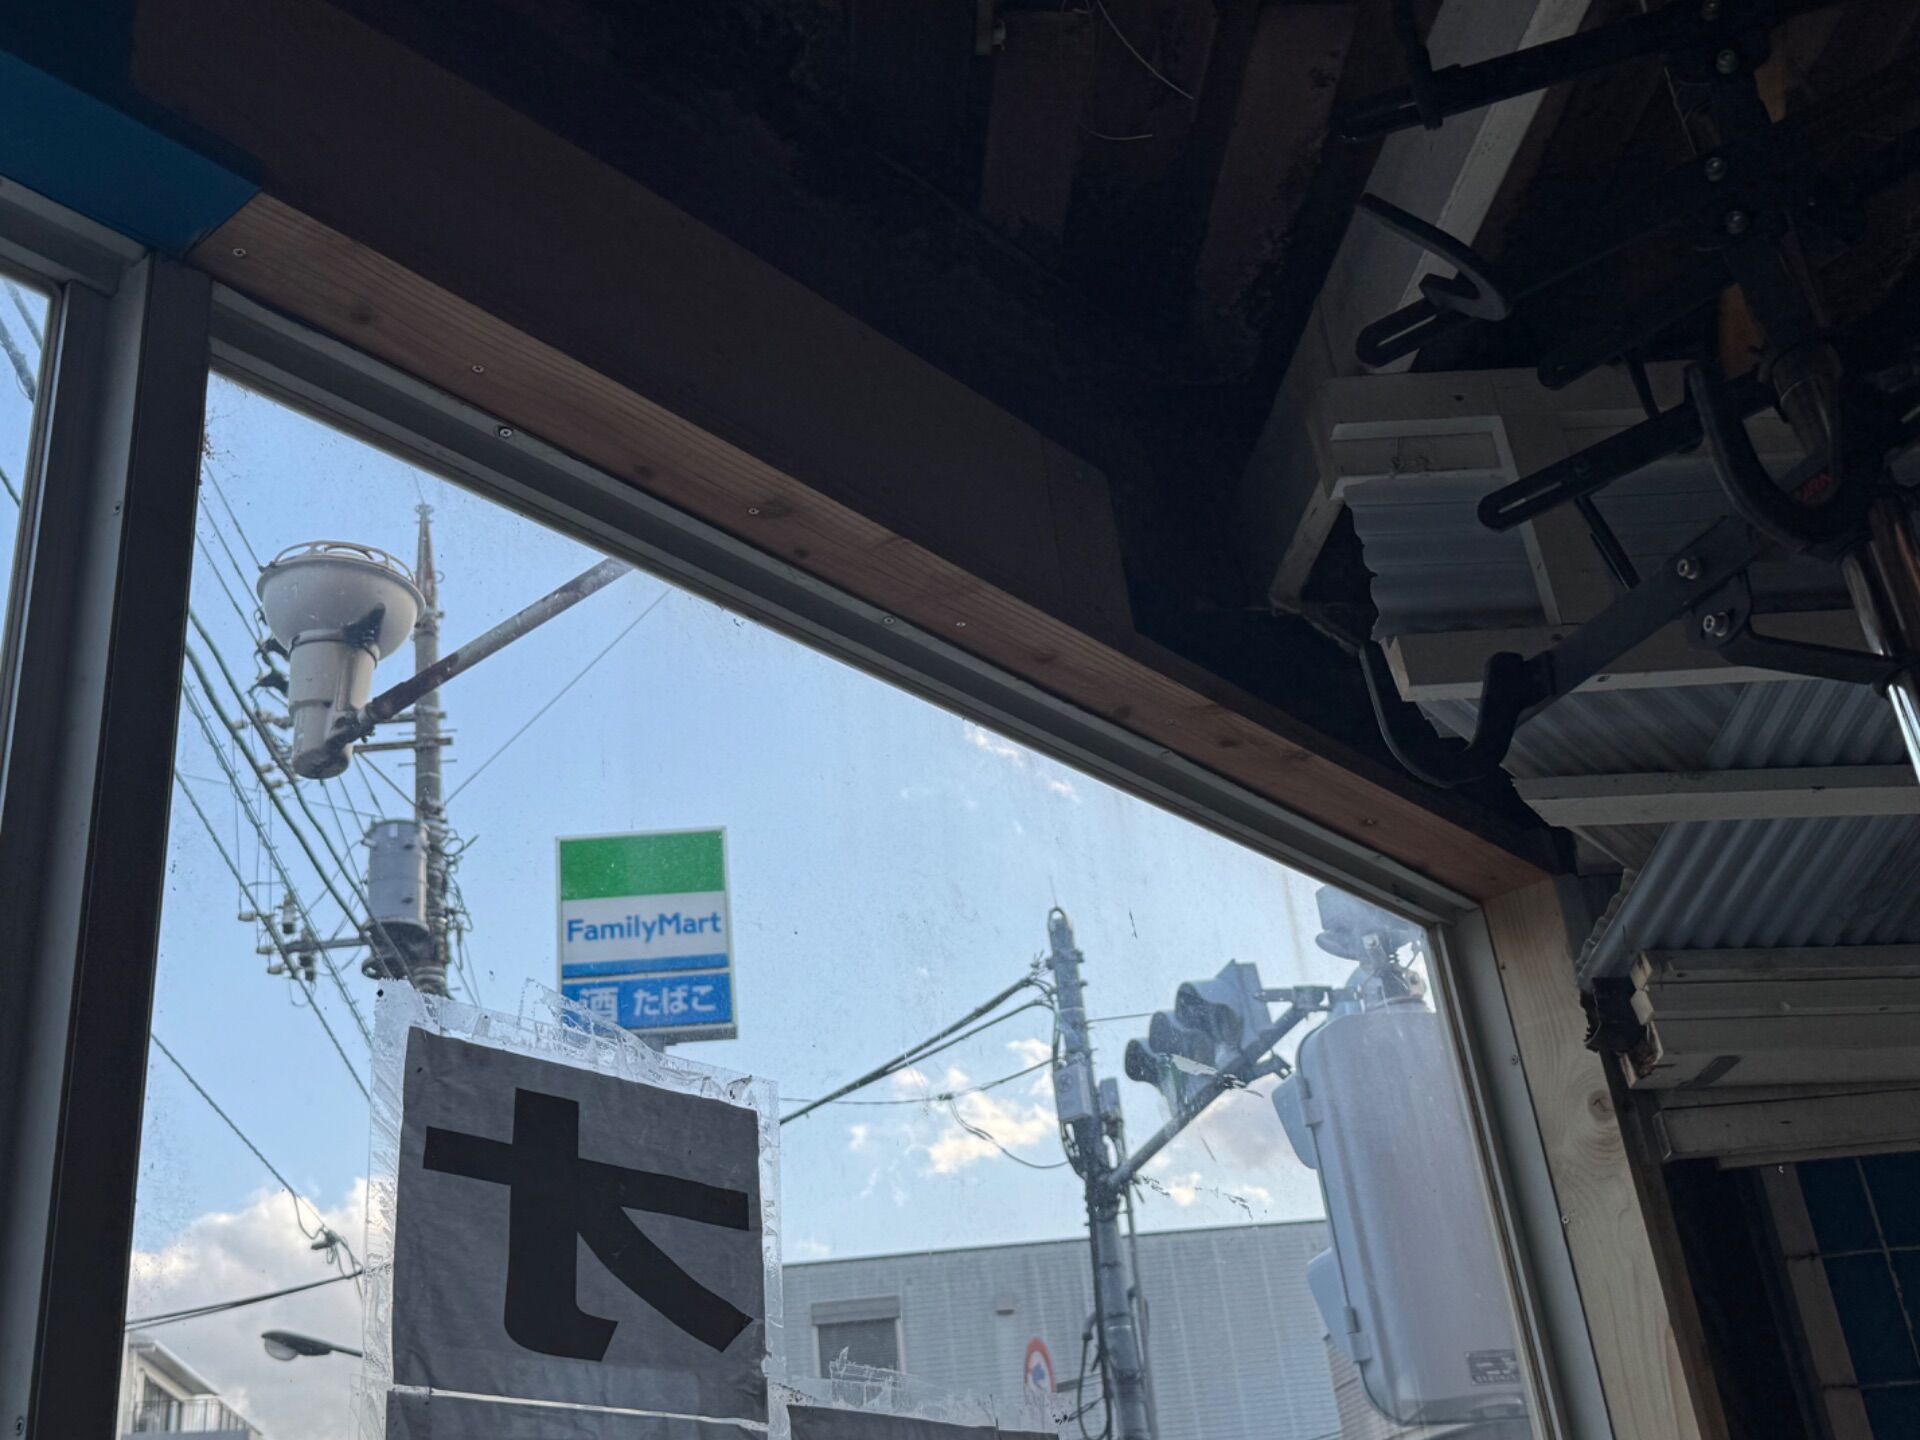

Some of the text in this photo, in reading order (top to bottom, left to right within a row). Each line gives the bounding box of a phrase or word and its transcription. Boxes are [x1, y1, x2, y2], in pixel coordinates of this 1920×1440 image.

[567, 912, 722, 943] FamilyMart
[633, 984, 717, 1017] たばこ
